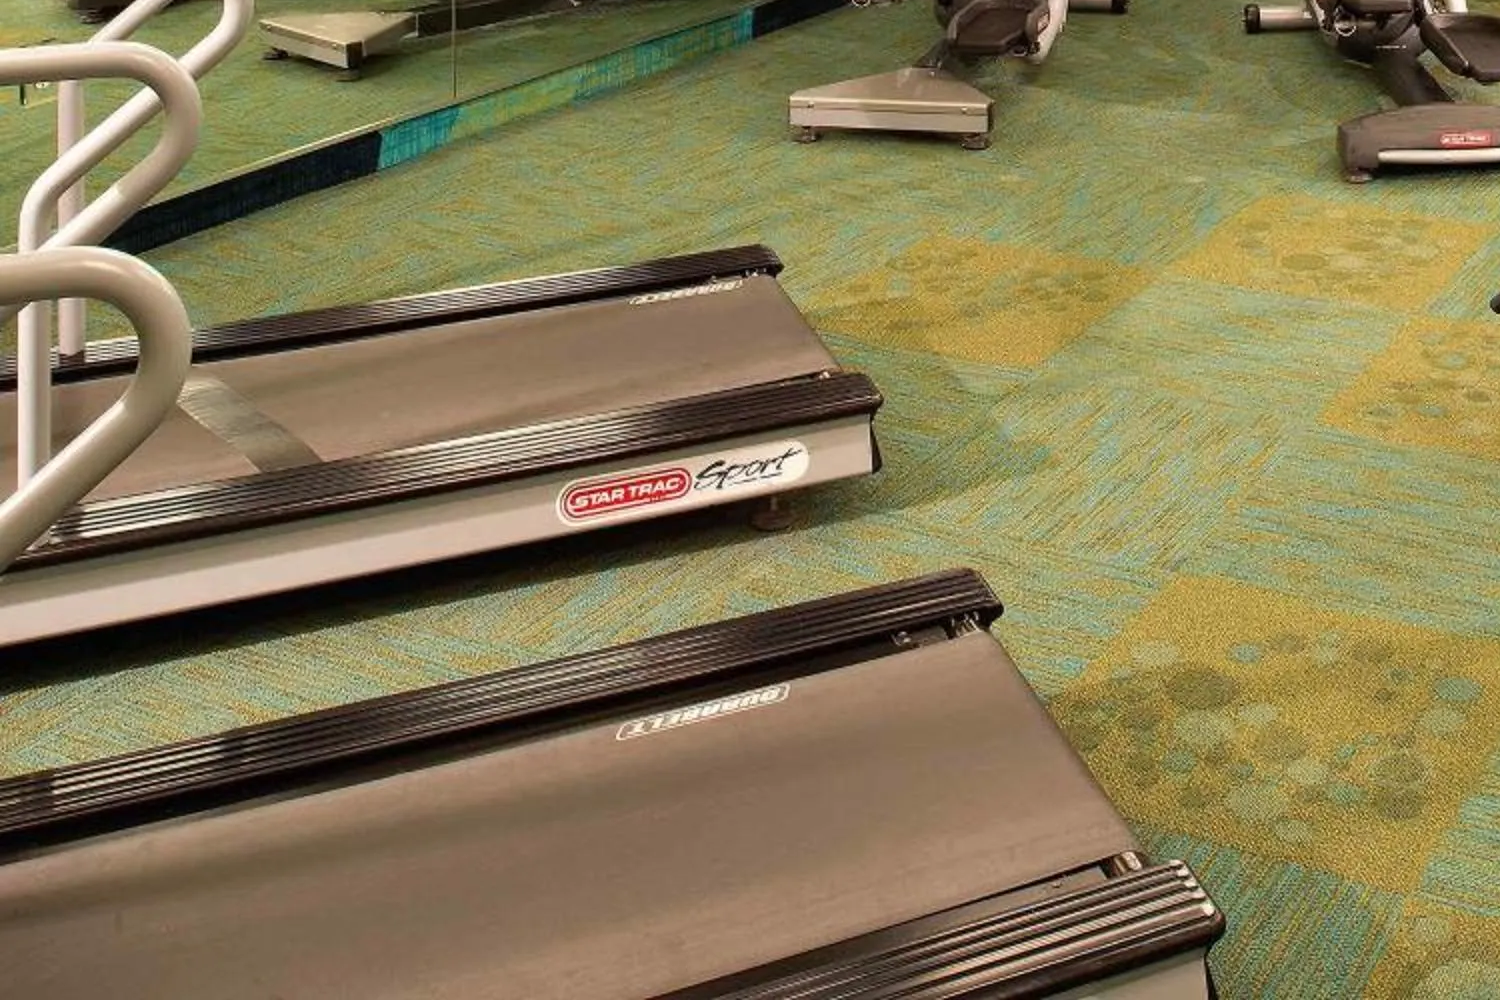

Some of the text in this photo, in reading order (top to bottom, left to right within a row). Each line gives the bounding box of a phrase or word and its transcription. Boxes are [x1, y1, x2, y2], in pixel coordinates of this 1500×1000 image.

[572, 447, 804, 508] STAR TRAC Sport
